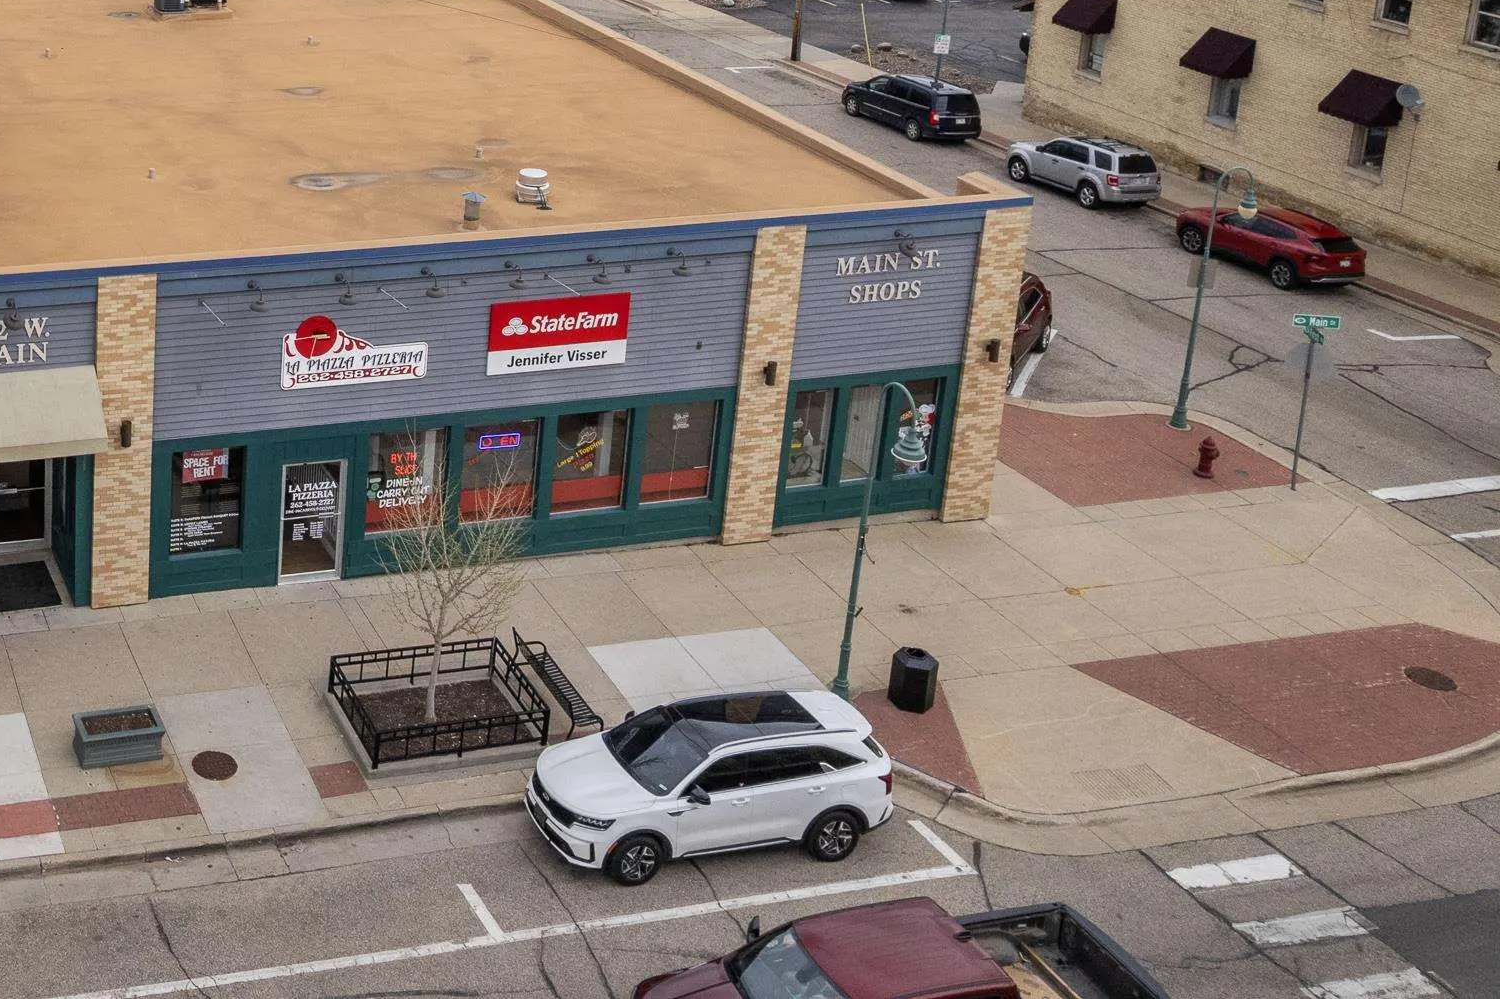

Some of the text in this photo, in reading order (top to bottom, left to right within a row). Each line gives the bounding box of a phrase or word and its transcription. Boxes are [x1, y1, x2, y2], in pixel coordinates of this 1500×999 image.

[836, 249, 941, 276] MAIN ST.
[848, 280, 921, 304] SHOPS
[24, 317, 50, 339] W.
[1310, 316, 1328, 327] Main
[285, 350, 424, 376] LA PIAZZA PIZZERIA
[507, 349, 608, 368] Jennifer Visser
[482, 436, 518, 447] OEN
[183, 454, 229, 469] SPACE FOR
[193, 466, 216, 478] RENT
[288, 481, 338, 493] LA PIAZZA
[386, 476, 423, 488] DINE-N
[292, 490, 334, 501] PIZZERIA
[376, 488, 408, 499] CARRY
[379, 495, 427, 509] DELIVEY
